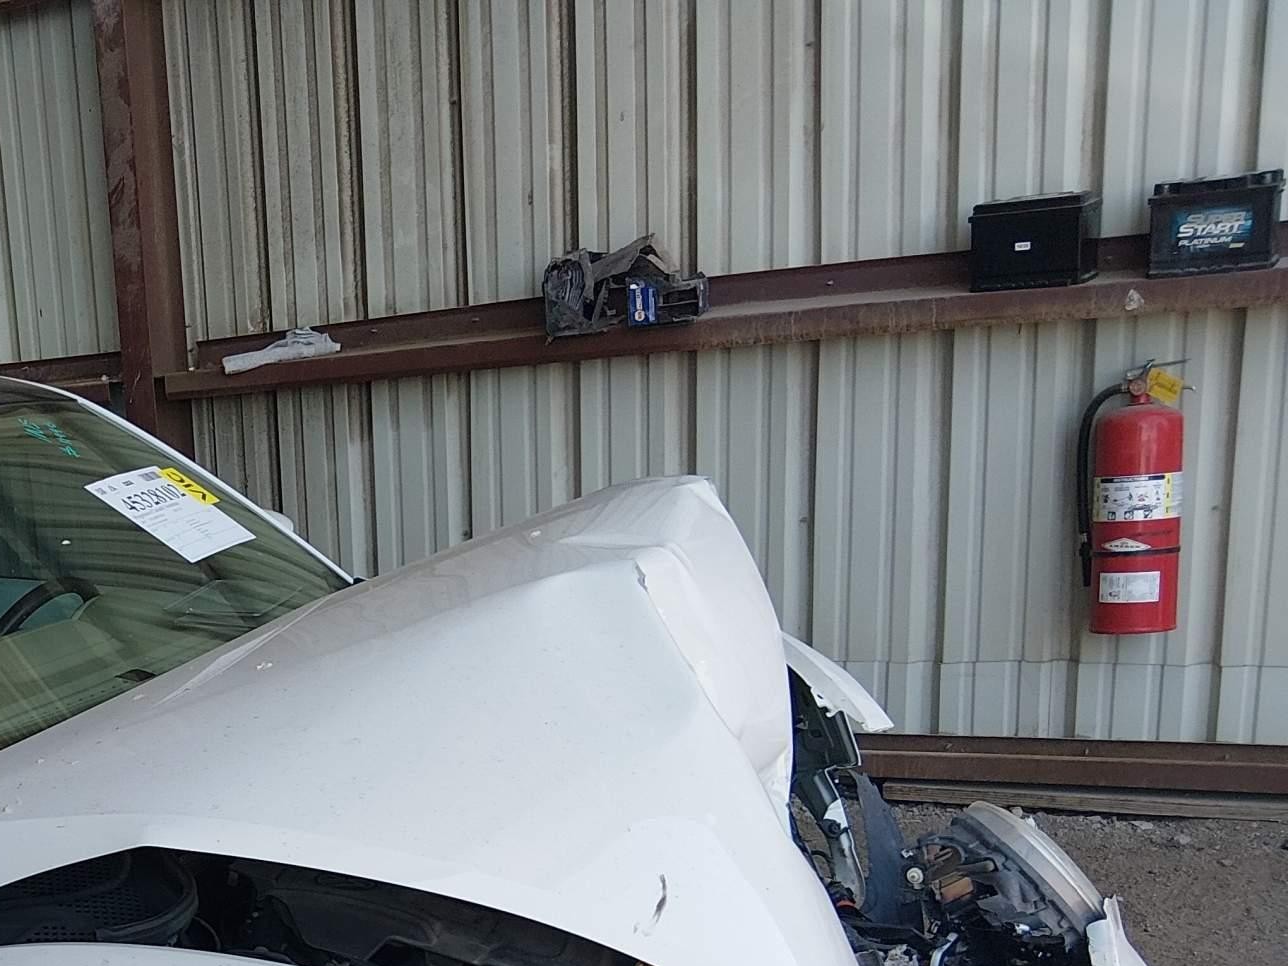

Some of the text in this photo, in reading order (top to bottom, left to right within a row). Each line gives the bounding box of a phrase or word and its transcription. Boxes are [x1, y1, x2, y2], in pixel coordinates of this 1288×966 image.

[1176, 221, 1243, 238] START
[1178, 235, 1233, 247] PLATINUM
[121, 483, 187, 513] 45328102
